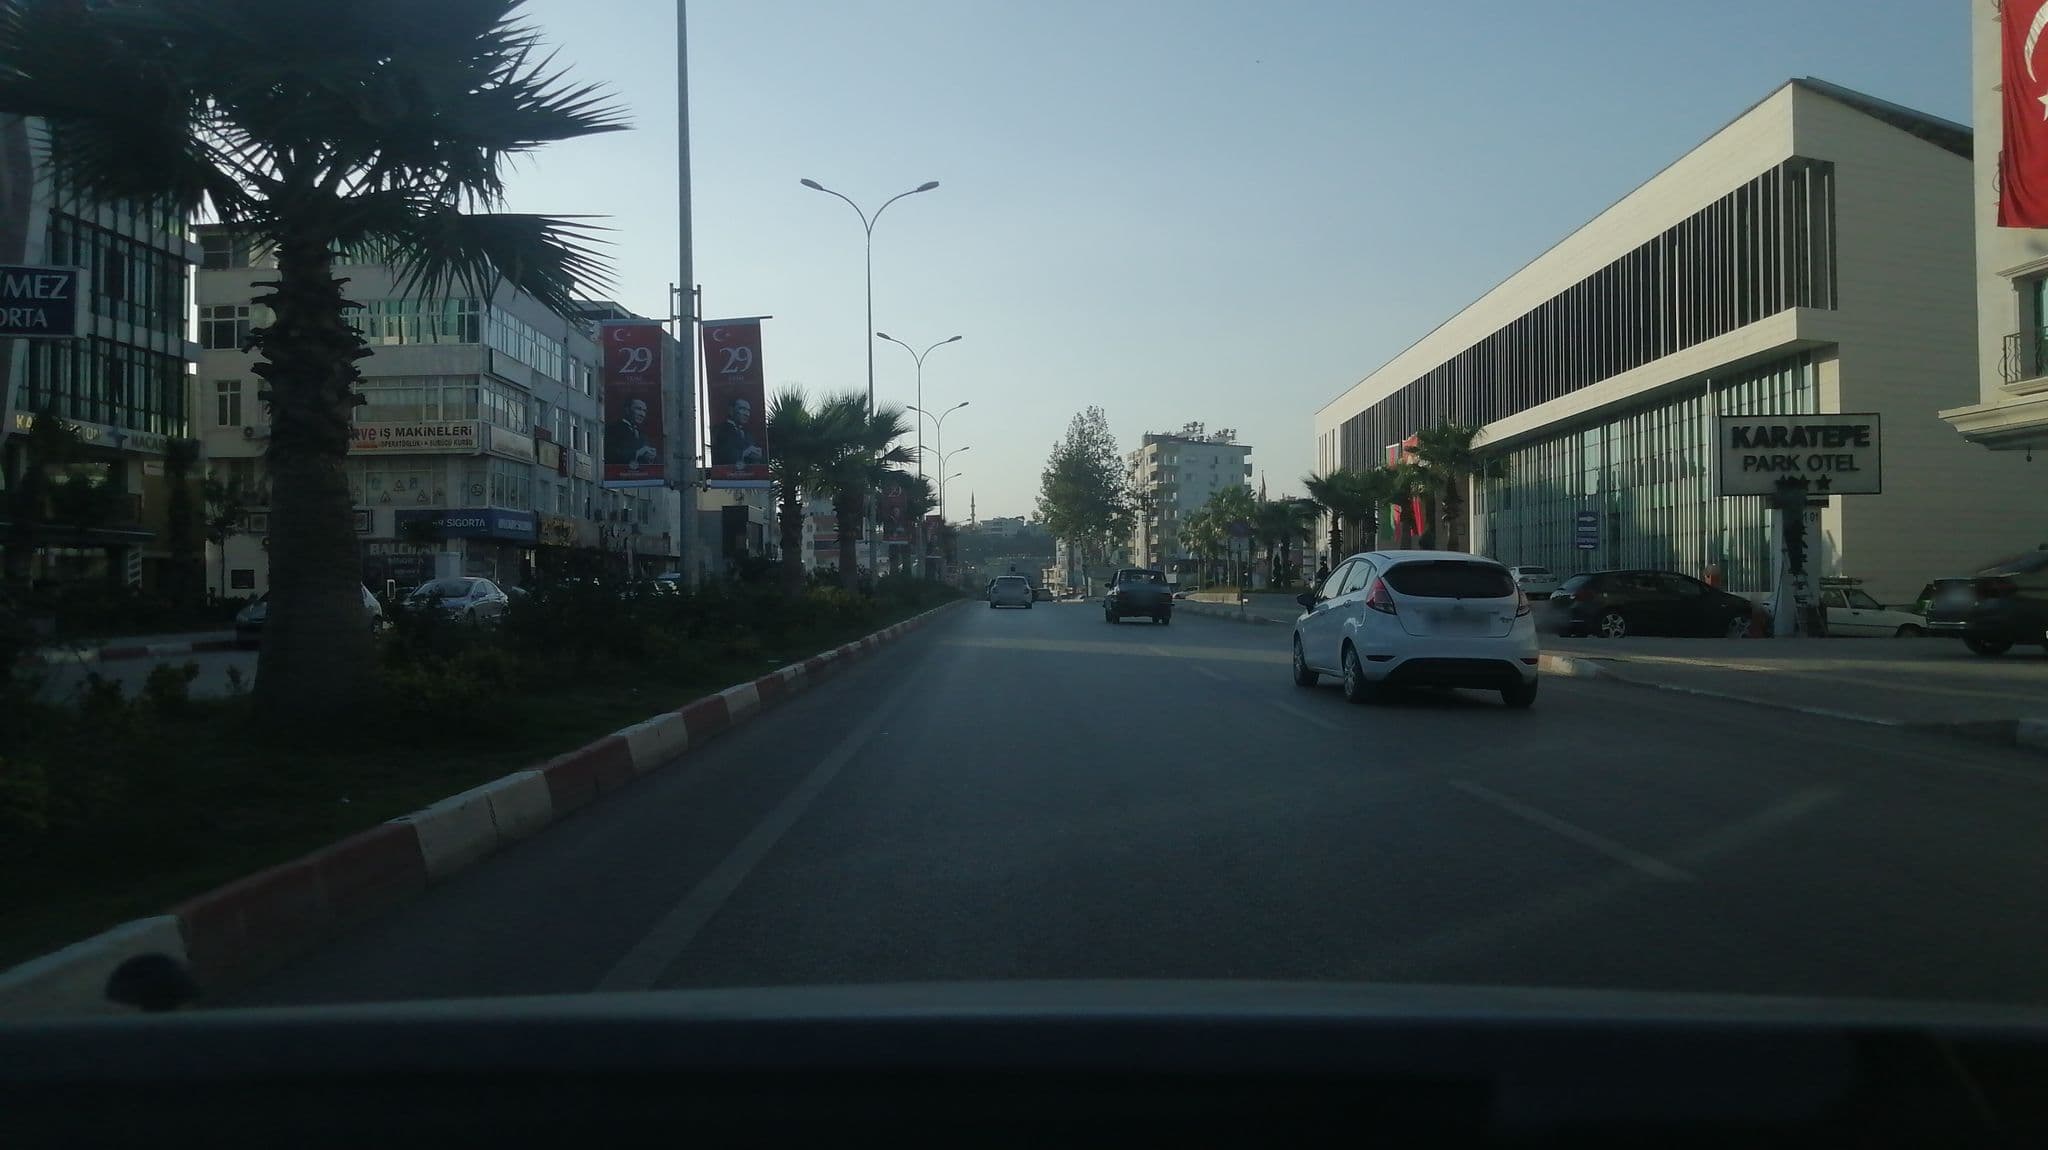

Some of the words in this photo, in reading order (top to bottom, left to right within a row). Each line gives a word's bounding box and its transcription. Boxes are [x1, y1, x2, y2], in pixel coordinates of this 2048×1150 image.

[0, 272, 69, 299] MEZ
[618, 346, 653, 374] 29
[719, 346, 753, 374] 29
[1732, 425, 1870, 449] KARATEPE
[1743, 455, 1801, 472] PARK
[1807, 454, 1860, 472] OTEL
